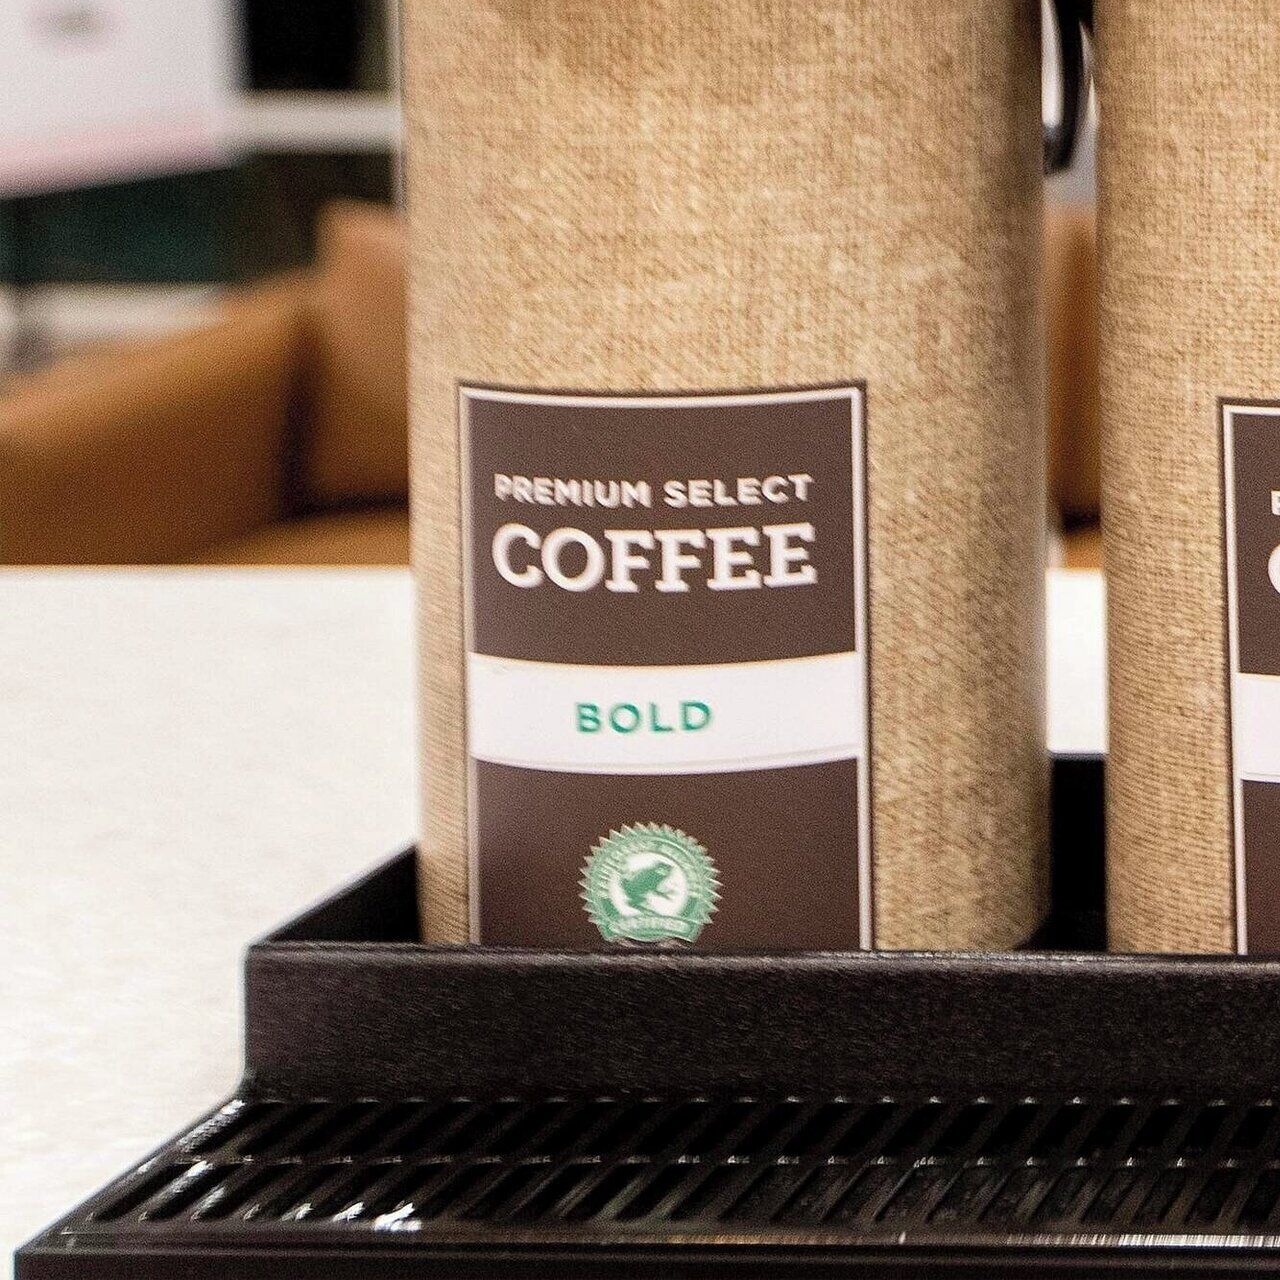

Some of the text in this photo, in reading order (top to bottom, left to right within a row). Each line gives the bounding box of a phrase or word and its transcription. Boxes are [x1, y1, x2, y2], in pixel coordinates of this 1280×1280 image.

[494, 472, 814, 508] PREMIUM SELECT
[491, 521, 818, 593] COFFEE
[574, 701, 712, 734] BOLD
